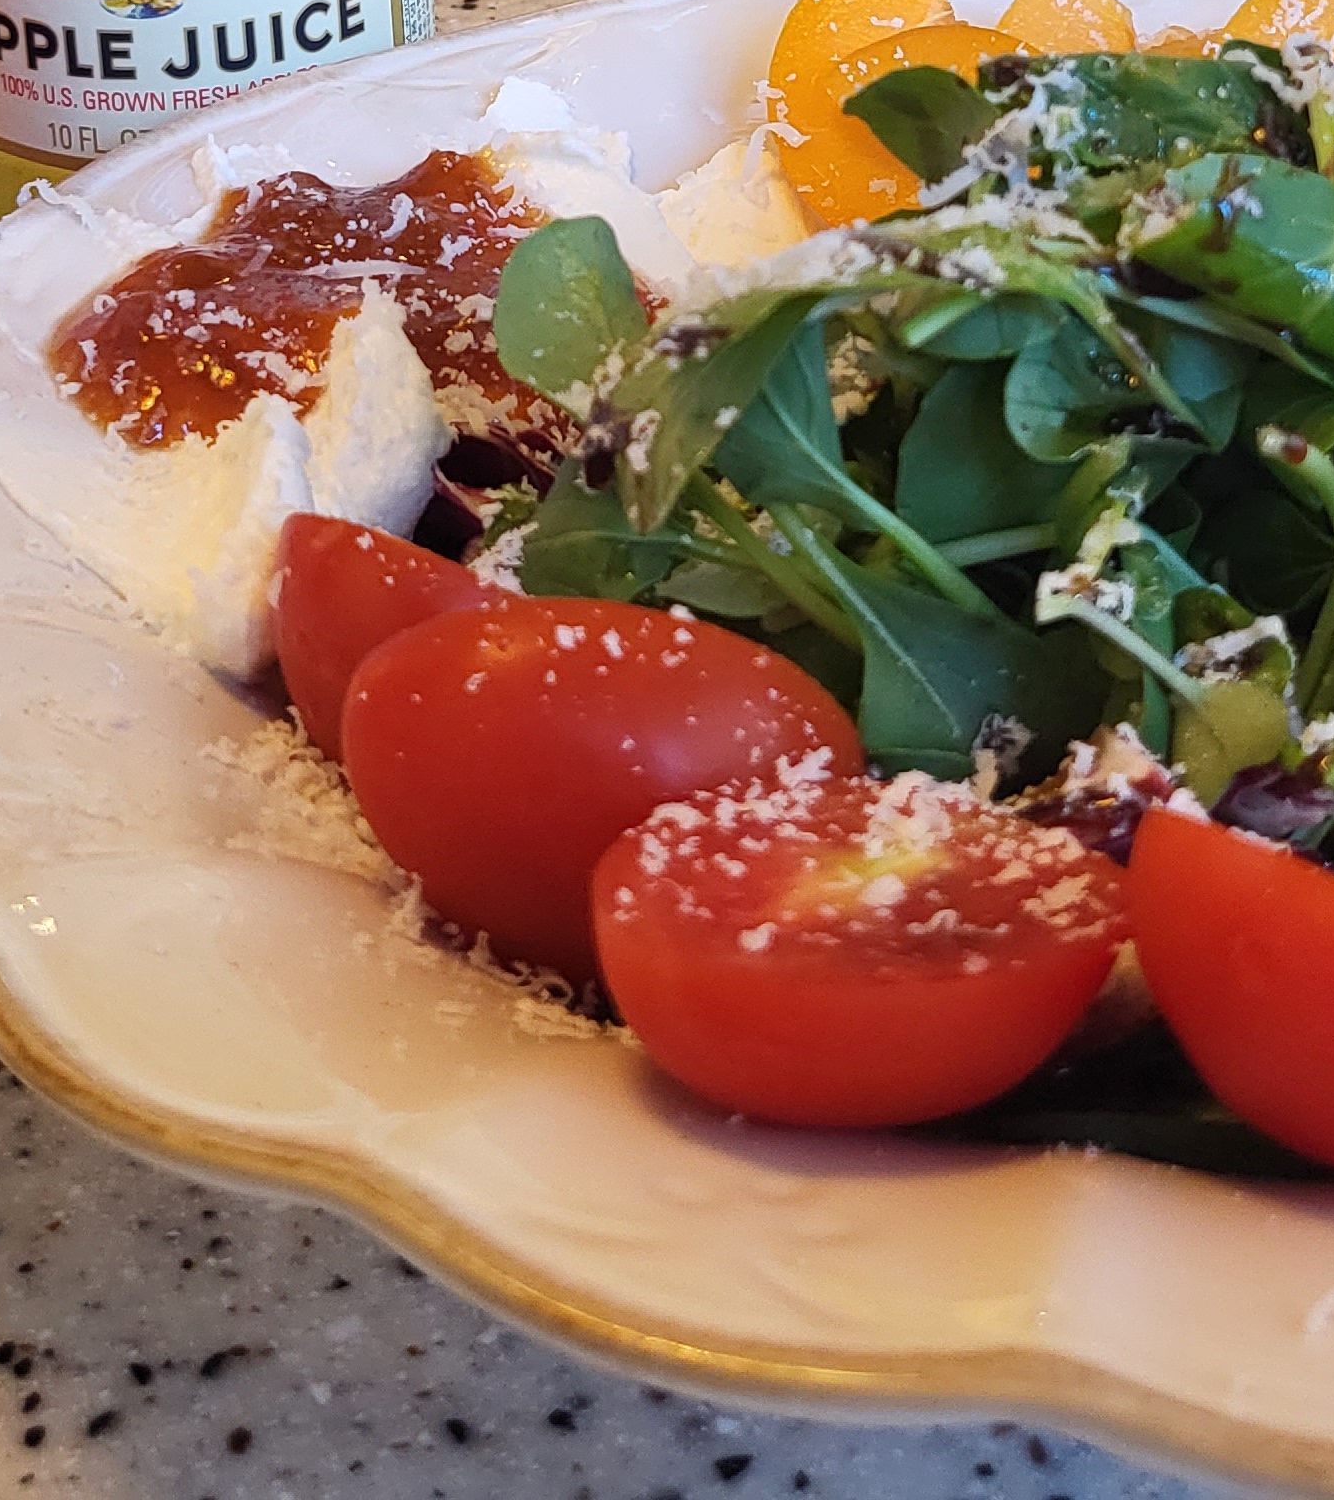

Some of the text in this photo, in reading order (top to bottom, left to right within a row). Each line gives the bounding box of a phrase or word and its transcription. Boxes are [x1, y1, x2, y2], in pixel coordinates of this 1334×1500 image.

[0, 73, 241, 113] 100% U.S. GROWN FRESH
[48, 123, 72, 151] 10
